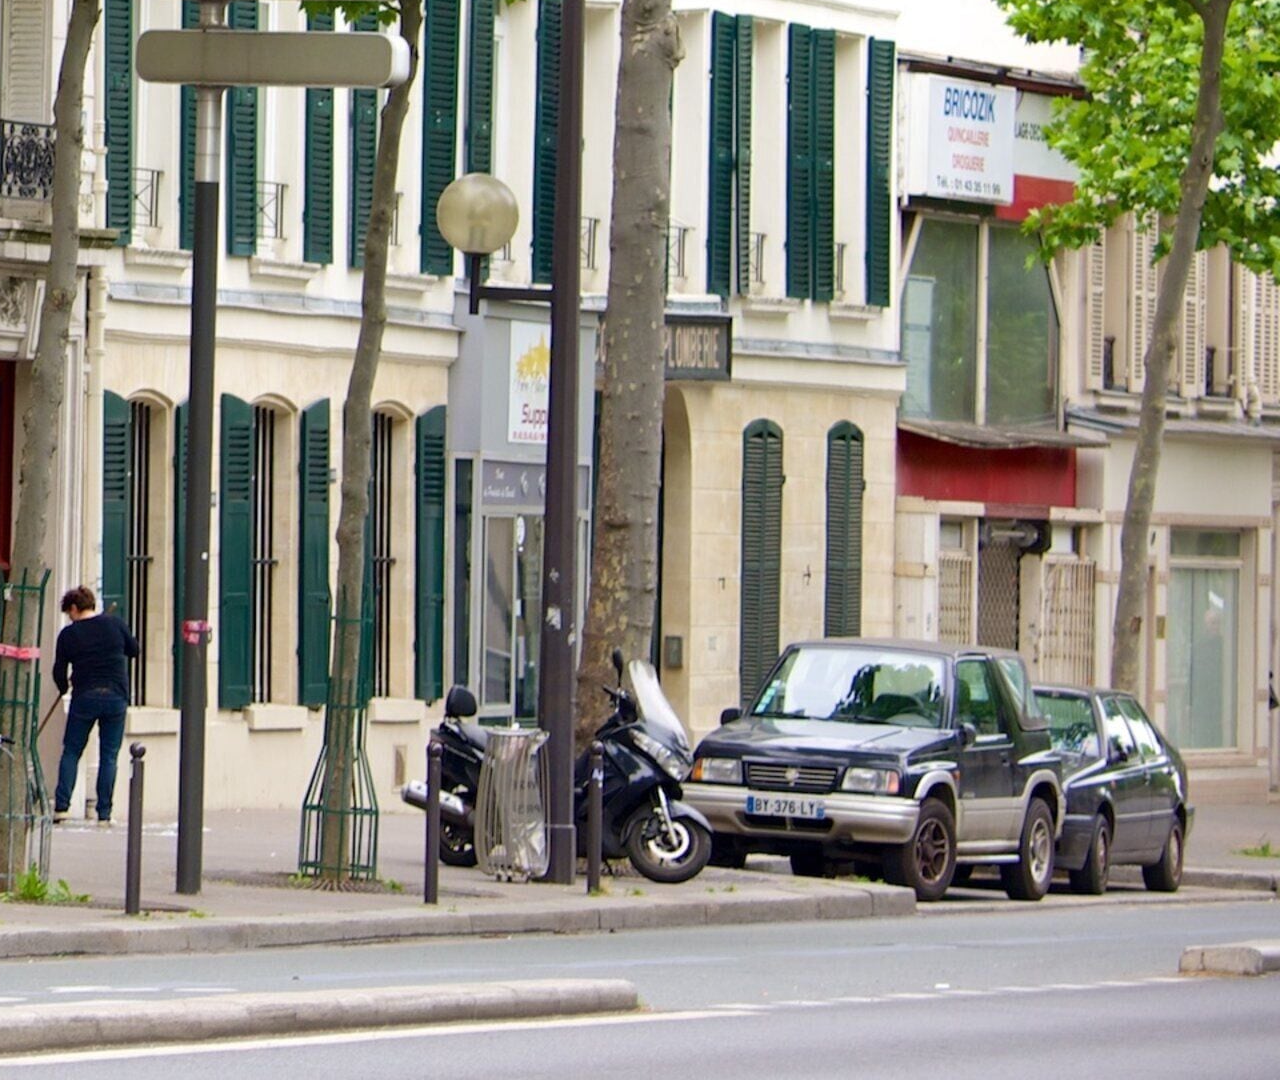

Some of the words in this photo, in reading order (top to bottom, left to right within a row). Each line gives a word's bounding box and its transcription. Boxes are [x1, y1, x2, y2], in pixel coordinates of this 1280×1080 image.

[944, 87, 997, 122] BRICOZIK
[947, 126, 990, 147] QUINCAILLERIE
[952, 154, 985, 172] DROGUERIE
[662, 326, 720, 369] PLOMBERIE
